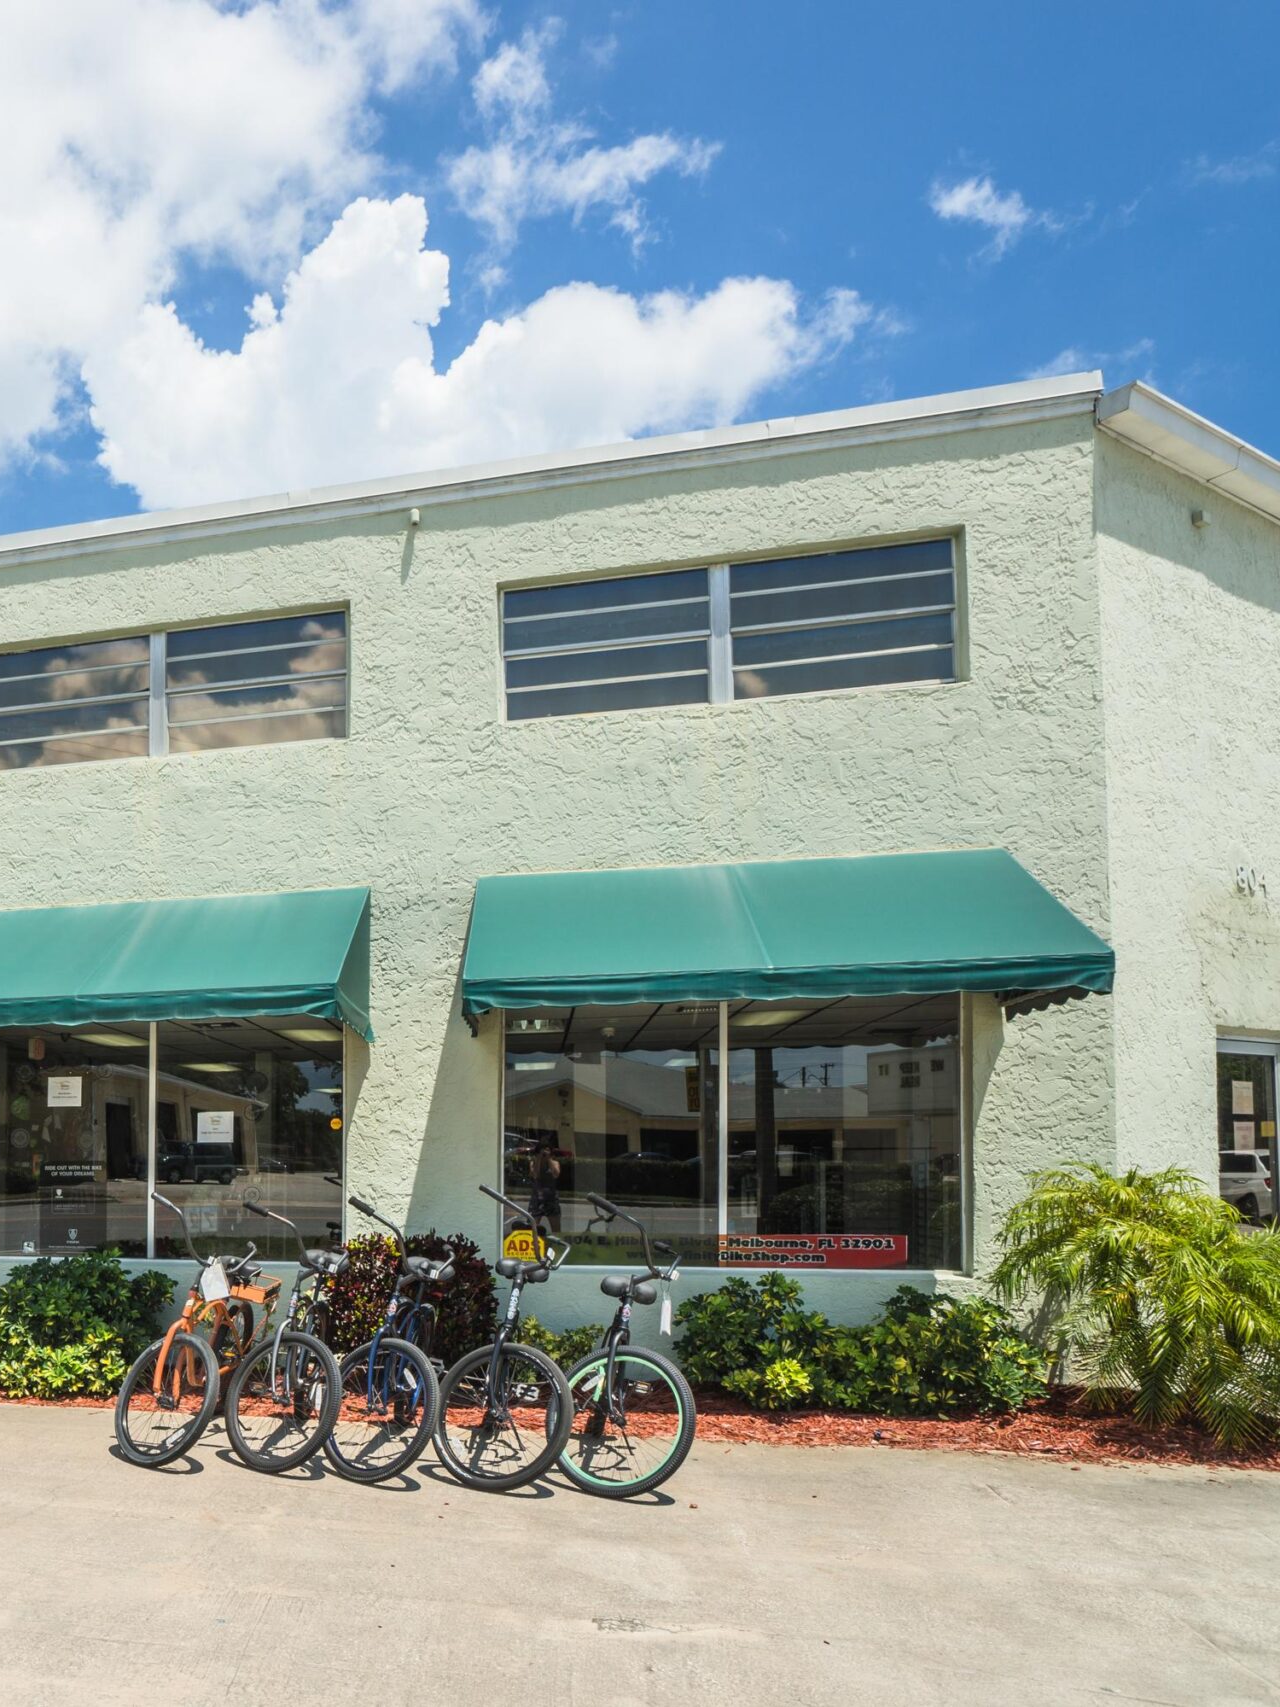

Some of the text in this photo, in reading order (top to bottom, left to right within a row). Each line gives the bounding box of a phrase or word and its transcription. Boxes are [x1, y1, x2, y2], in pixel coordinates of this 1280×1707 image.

[728, 1237, 814, 1250] Melbourne,
[818, 1237, 837, 1249] FL
[841, 1237, 895, 1250] 32901
